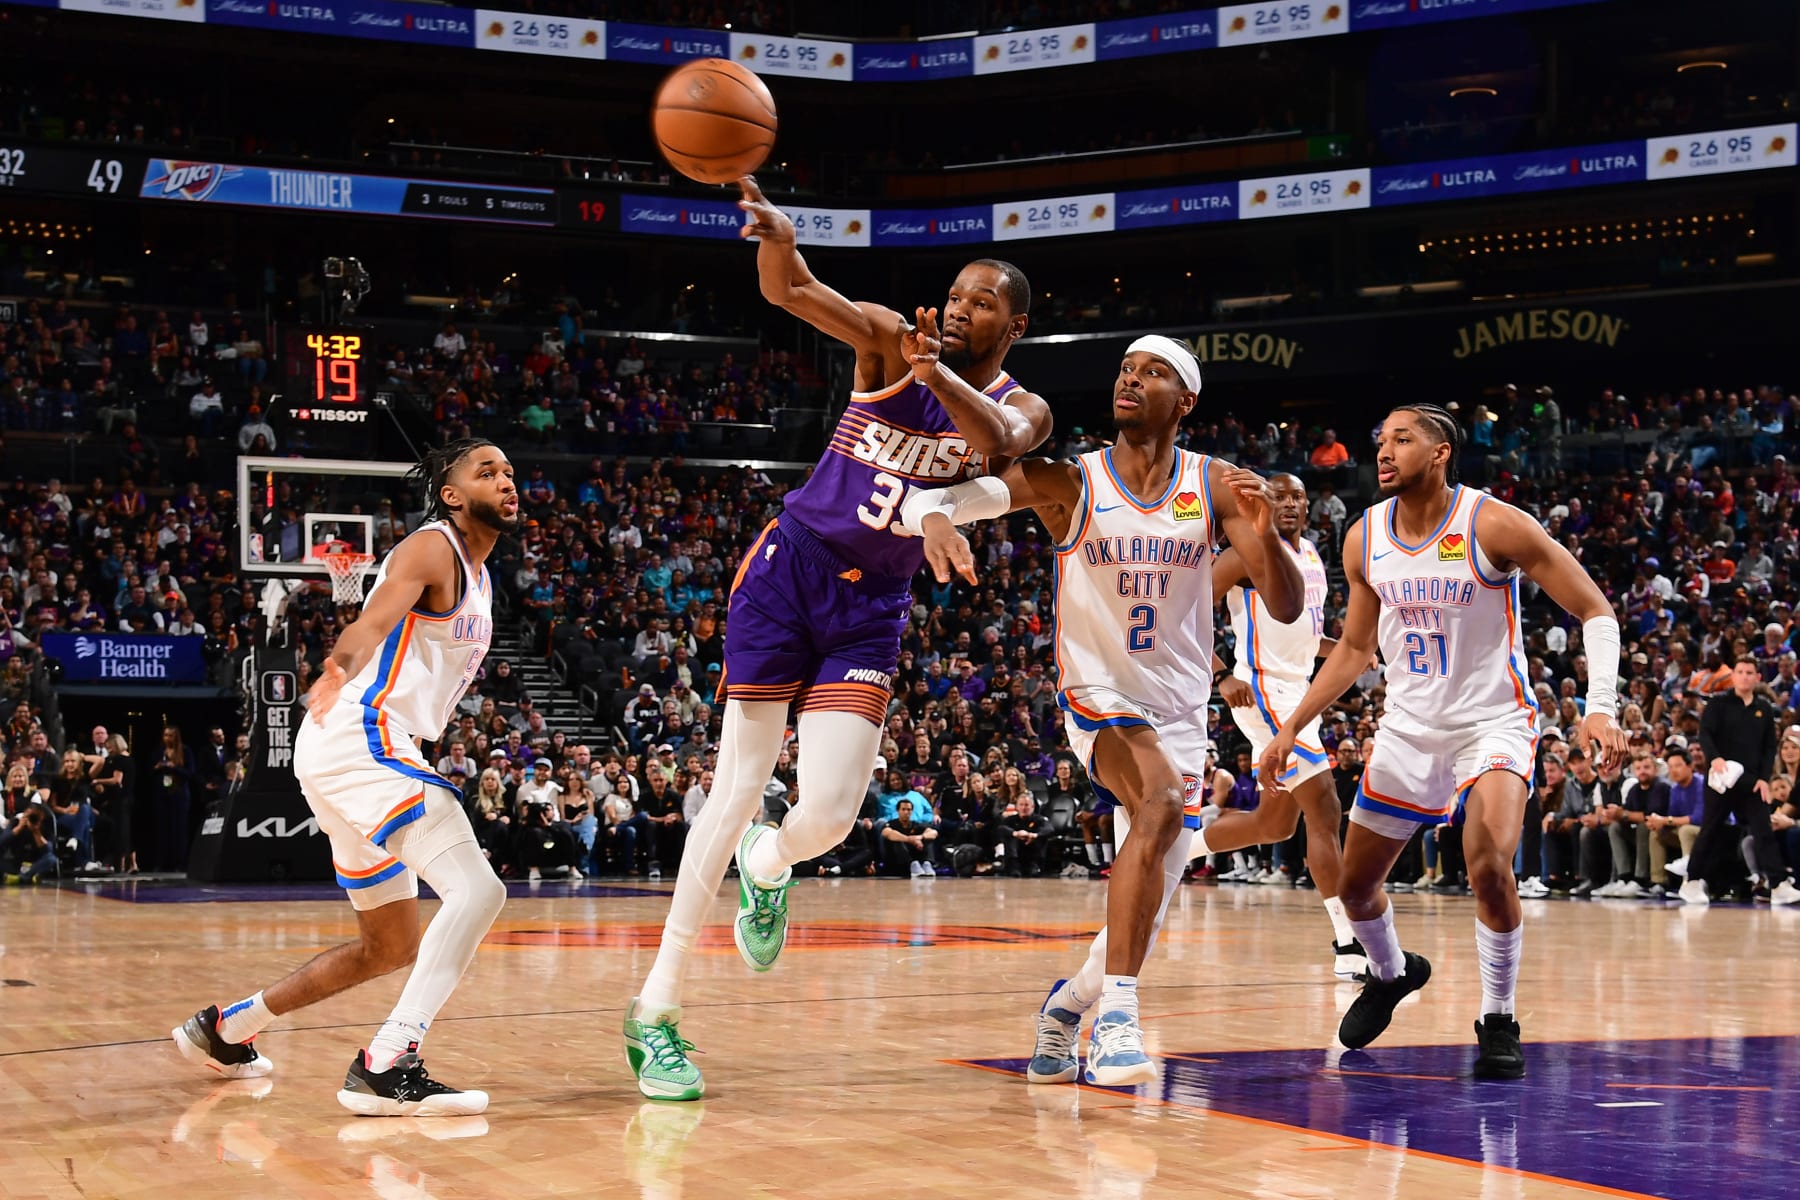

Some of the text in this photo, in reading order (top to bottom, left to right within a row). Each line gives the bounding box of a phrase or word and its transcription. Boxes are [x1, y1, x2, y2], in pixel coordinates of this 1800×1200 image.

[279, 4, 336, 21] ULTRA
[1255, 5, 1310, 25] 2.6 95
[415, 17, 470, 33] ULTRA
[513, 20, 569, 39] 2.6 95
[1160, 23, 1213, 40] ULTRA
[673, 41, 723, 56] ULTRA
[765, 43, 818, 61] 2.6 95
[1008, 35, 1060, 54] 2.6 95
[920, 52, 969, 67] ULTRA
[1690, 136, 1752, 157] 2.6 95
[1581, 154, 1638, 173] ULTRA
[87, 159, 123, 193] 49
[163, 165, 210, 193] OKC
[1442, 169, 1497, 187] ULTRA
[267, 171, 352, 208] THUNDER
[1276, 179, 1331, 199] 2.6 95
[421, 193, 546, 212] 3 FOULS 5 TIMEOUTS
[579, 201, 606, 223] 19
[1028, 203, 1079, 222] 2.6 95
[1181, 195, 1232, 212] ULTRA
[689, 211, 739, 227] ULTRA
[813, 215, 833, 230] 95
[939, 218, 986, 233] ULTRA
[1453, 309, 1622, 358] JAMESON
[307, 334, 361, 359] 4:32
[1184, 332, 1297, 369] MESON
[316, 359, 357, 402] 19
[311, 409, 369, 422] TISSOT
[853, 421, 967, 478] SUNS
[1083, 536, 1206, 569] OKLAHOMA
[1117, 569, 1172, 598] CITY
[1377, 577, 1477, 607] KLAHOMA
[1127, 602, 1158, 654] 2
[1399, 606, 1443, 631] CITY
[100, 639, 174, 659] Banner
[1404, 631, 1450, 679] 21
[100, 658, 166, 678] Health
[844, 668, 892, 690] PHOEN
[267, 706, 291, 727] GET
[267, 727, 292, 747] THE
[267, 748, 292, 768] APP
[1183, 781, 1197, 792] KC
[237, 816, 320, 838] KIA
